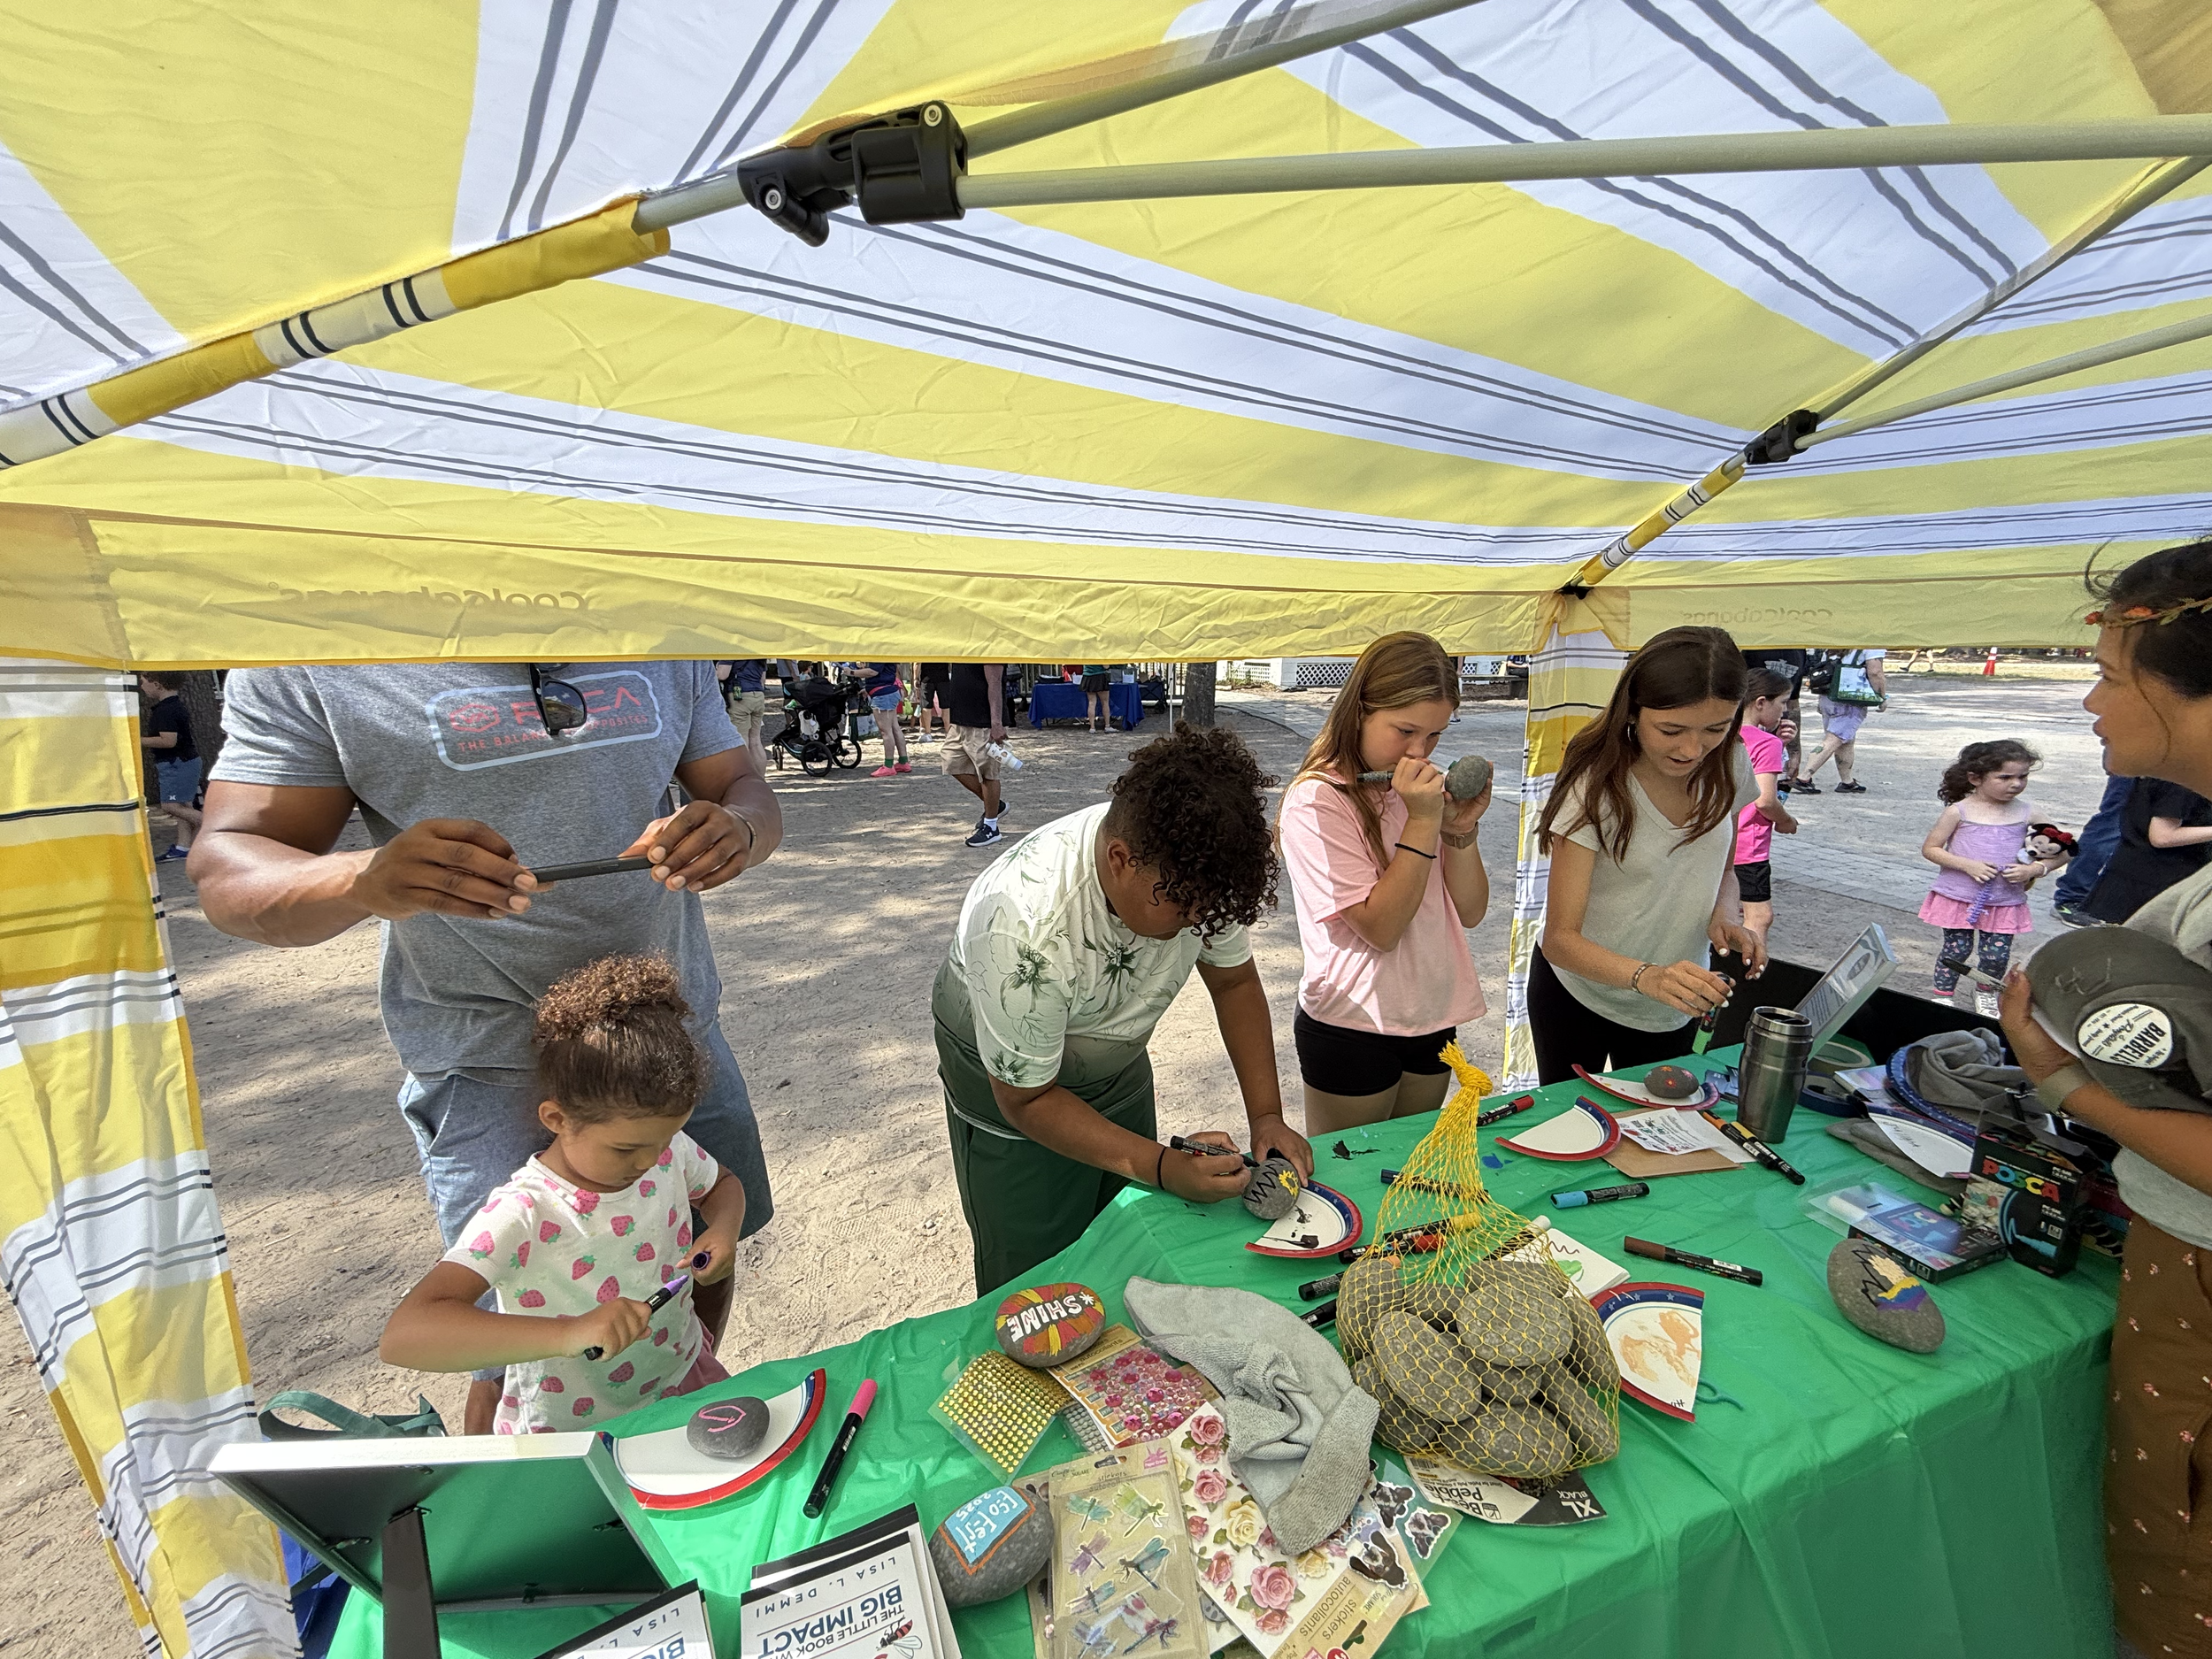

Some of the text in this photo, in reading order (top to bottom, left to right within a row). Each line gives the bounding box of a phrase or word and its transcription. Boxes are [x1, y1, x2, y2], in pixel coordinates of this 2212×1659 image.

[511, 687, 641, 725] RCA
[458, 739, 487, 753] THE
[494, 730, 550, 748] BALAN
[1982, 1158, 2060, 1203] POSCA
[1006, 1294, 1083, 1343] SHINE
[956, 1493, 991, 1521] 2025
[1423, 1483, 1484, 1502] Pebble
[1556, 1490, 1589, 1500] BLACK
[1561, 1499, 1601, 1518] XL
[756, 1556, 896, 1618] LISA L. DEMMI
[757, 1585, 902, 1659] BIG IMPACT
[879, 1604, 905, 1620] THE
[1299, 1575, 1352, 1638] autocollants
[1322, 1598, 1358, 1641] stickers
[600, 1608, 680, 1649] LISA L.
[837, 1617, 879, 1638] LITTLE
[796, 1636, 834, 1656] BOOK
